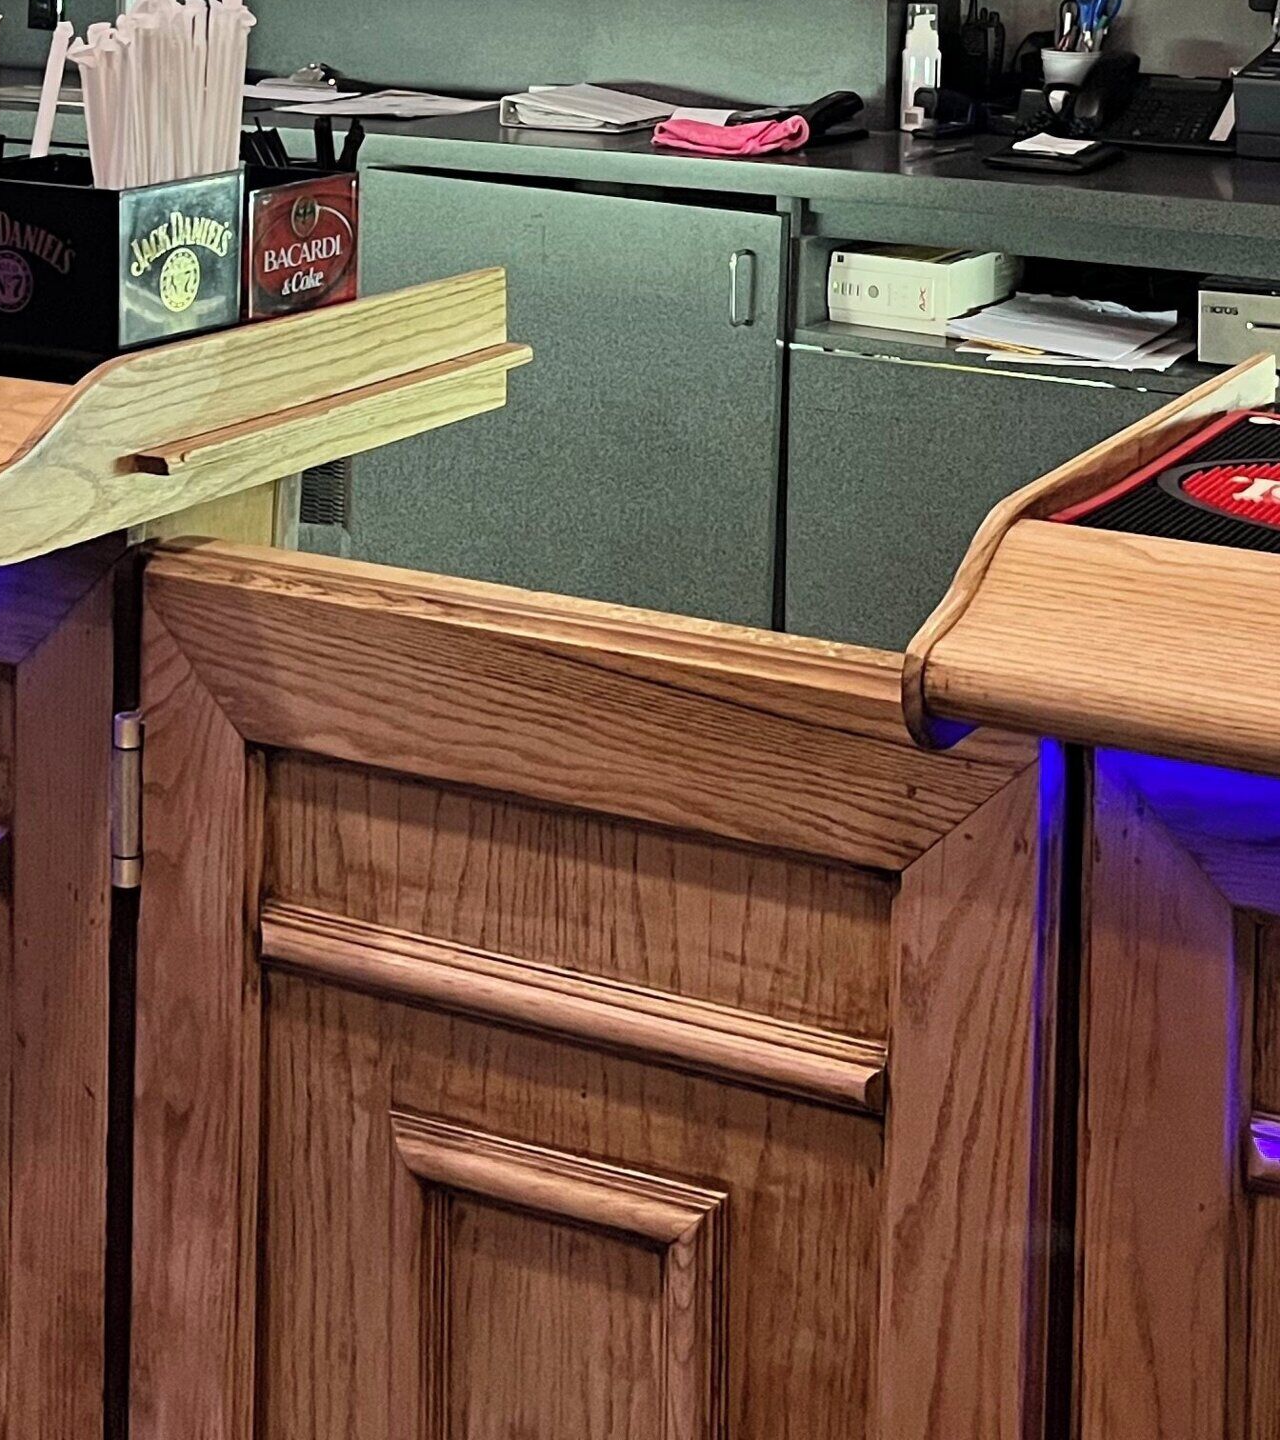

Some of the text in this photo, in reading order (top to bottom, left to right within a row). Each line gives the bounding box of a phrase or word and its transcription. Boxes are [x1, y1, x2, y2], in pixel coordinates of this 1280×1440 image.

[130, 211, 233, 277] JACK DANIEL'S
[263, 234, 342, 273] BACARDI
[289, 267, 325, 293] Coke
[1201, 305, 1239, 316] micros
